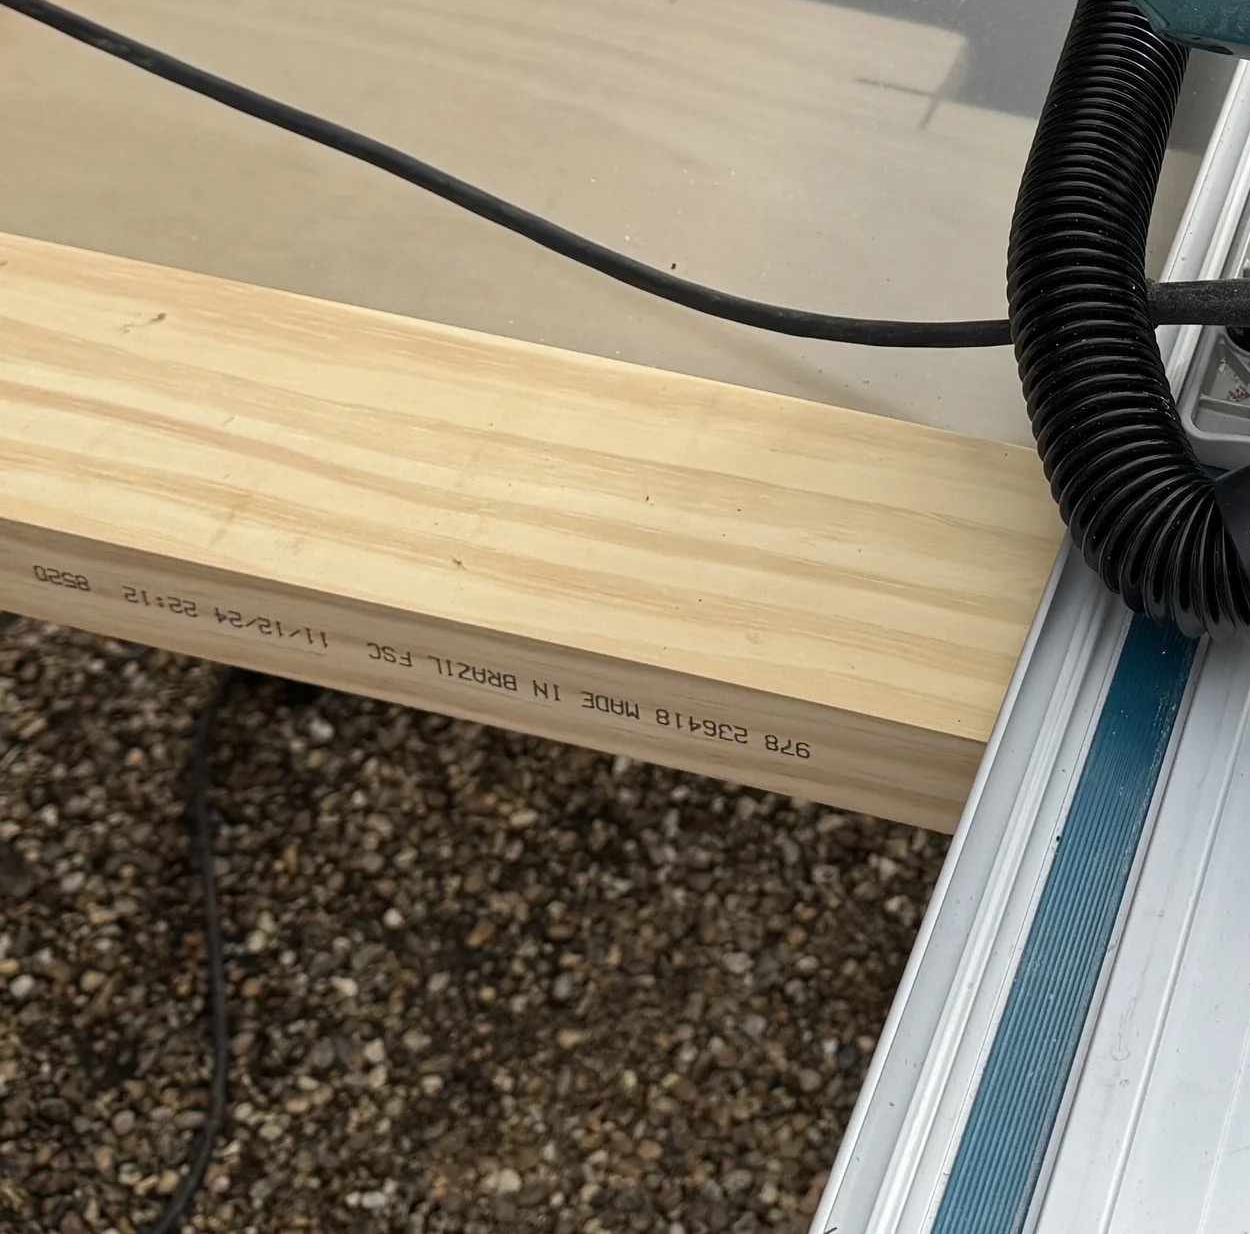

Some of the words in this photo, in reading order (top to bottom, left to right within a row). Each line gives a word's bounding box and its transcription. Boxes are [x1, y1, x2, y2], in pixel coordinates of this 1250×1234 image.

[33, 564, 91, 592] 8520
[123, 585, 199, 617] 22:12
[213, 606, 329, 647] 11/12/24
[366, 642, 413, 667] FSC
[428, 654, 518, 691] BRAZIL
[532, 679, 561, 702] IN
[580, 691, 640, 720] MADE
[655, 708, 749, 744] 236418
[764, 733, 811, 760] 978
